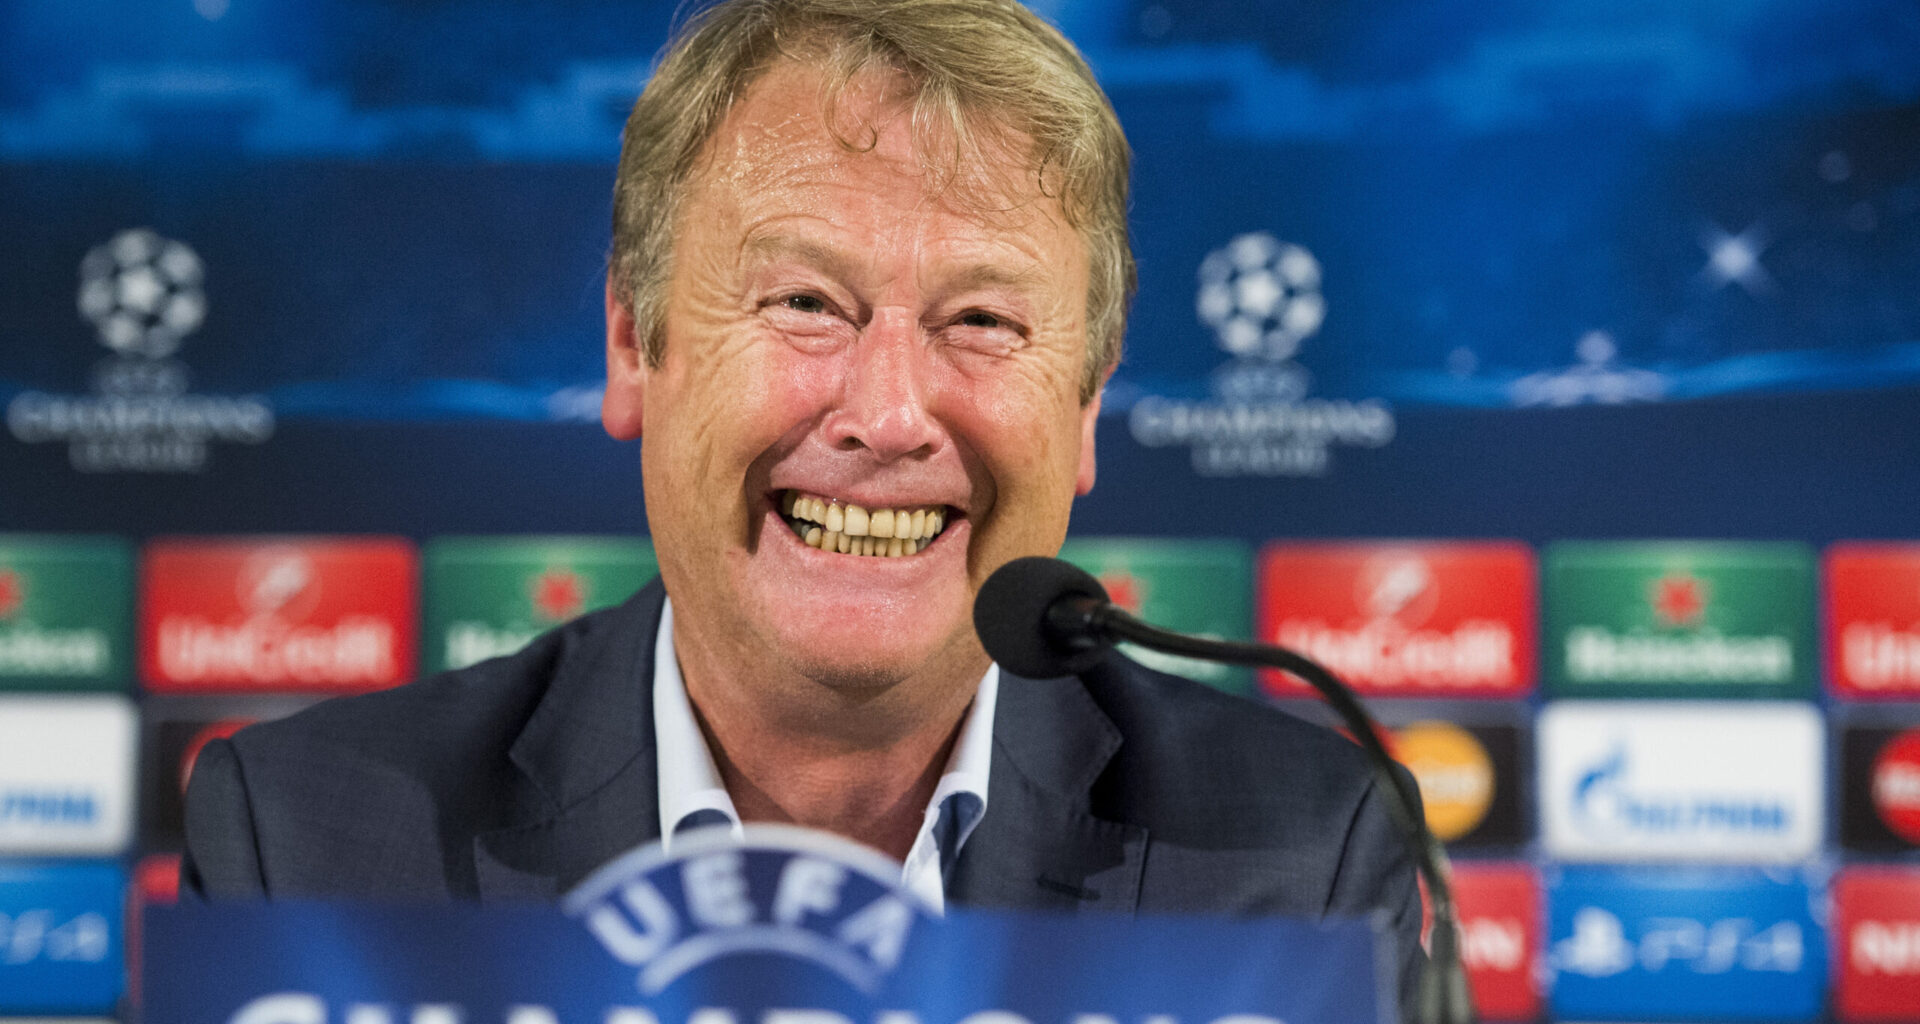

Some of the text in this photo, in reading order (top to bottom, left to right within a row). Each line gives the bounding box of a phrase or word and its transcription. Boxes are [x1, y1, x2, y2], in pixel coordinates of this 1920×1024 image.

[9, 395, 273, 438] CHAMPIONS
[1132, 400, 1393, 443] CHAMPIONS
[160, 617, 395, 680] UniCredit
[1567, 627, 1791, 681] Heineken
[588, 848, 909, 972] UEFA
